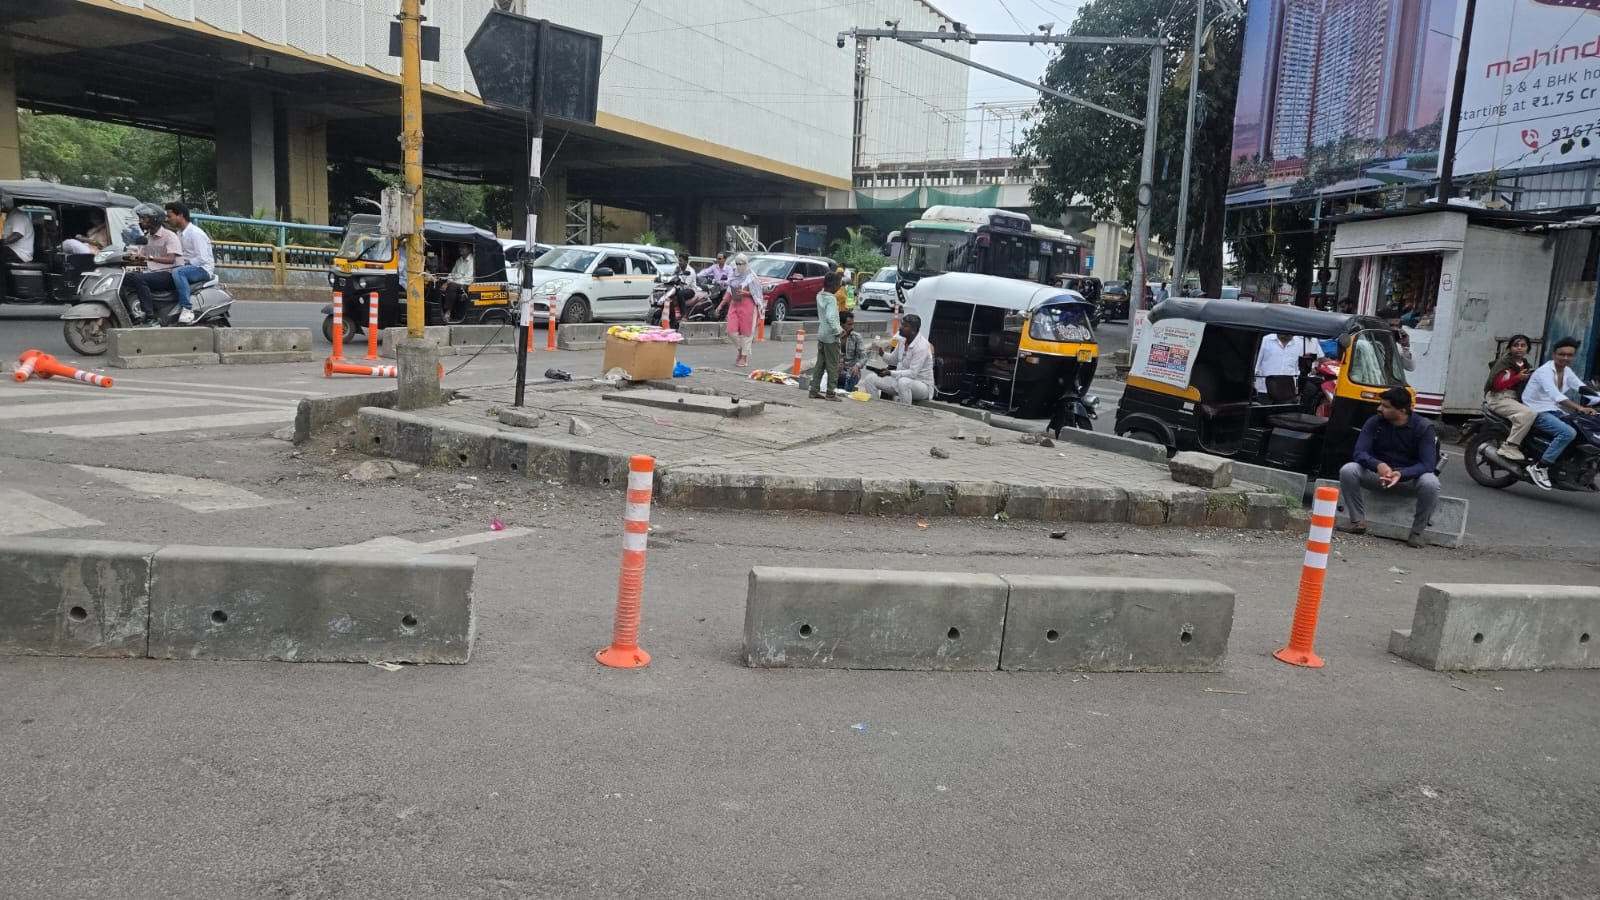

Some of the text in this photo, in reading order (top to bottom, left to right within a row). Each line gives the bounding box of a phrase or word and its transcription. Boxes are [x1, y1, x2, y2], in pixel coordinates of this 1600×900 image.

[1504, 84, 1513, 96] 3
[1518, 81, 1527, 93] &
[1532, 78, 1541, 89] 4
[1547, 71, 1578, 88] BHK
[1512, 100, 1526, 111] at
[1532, 90, 1574, 108] ₹1.75
[1580, 87, 1597, 100] Cr
